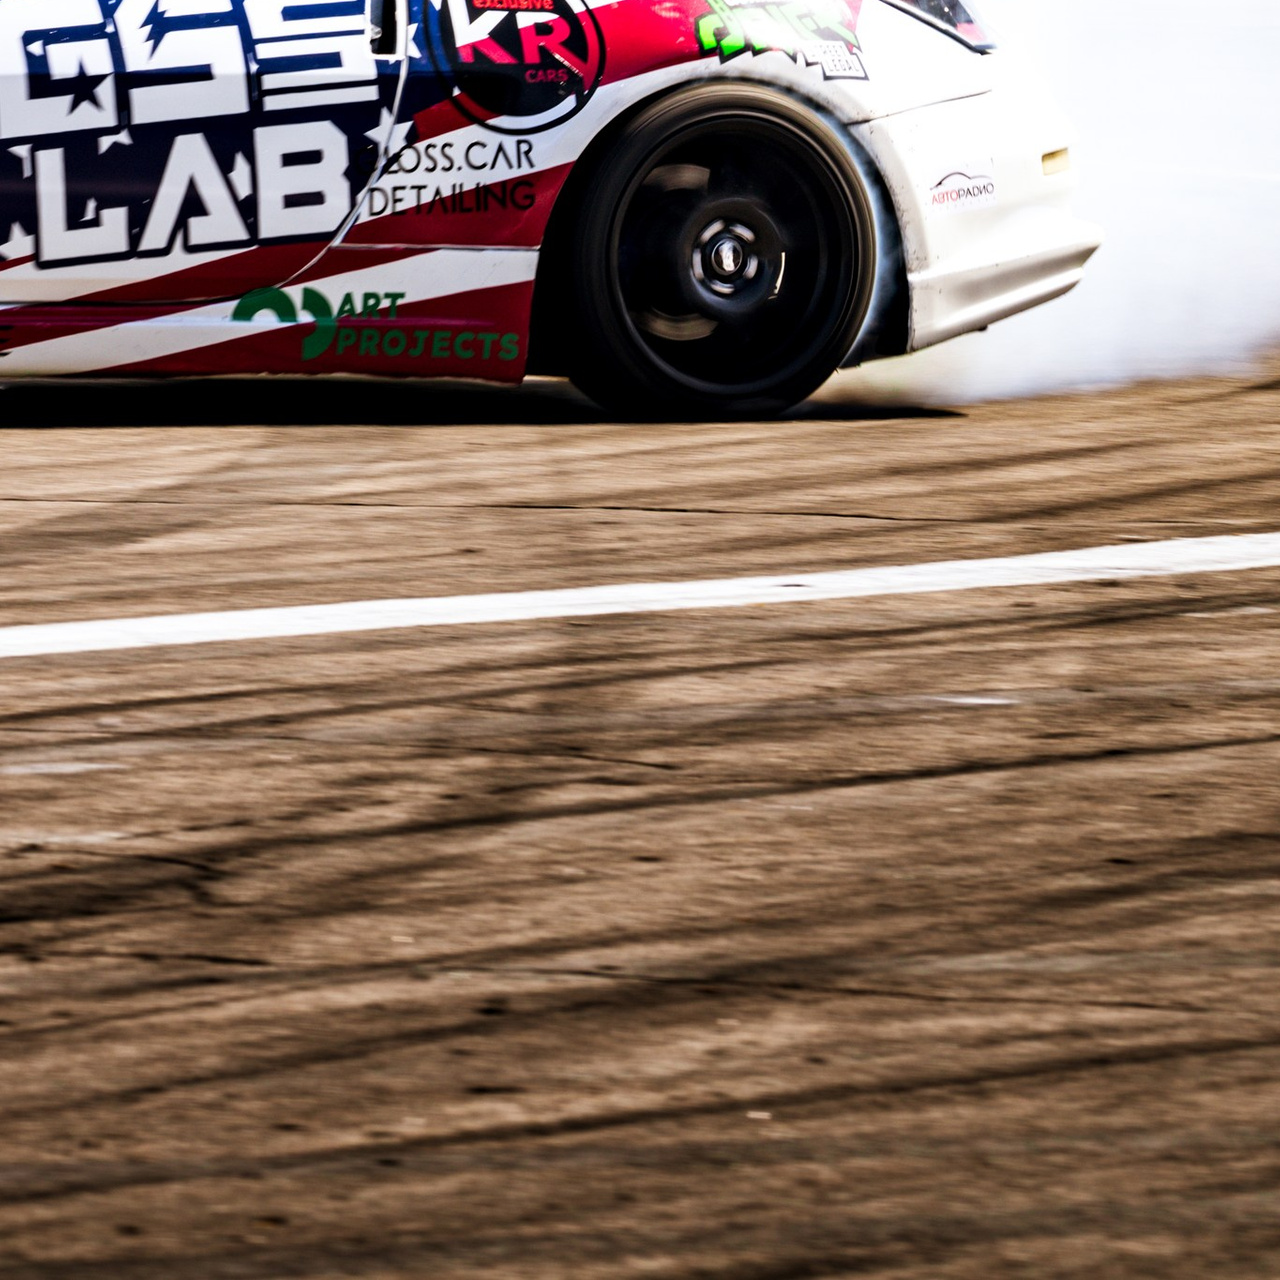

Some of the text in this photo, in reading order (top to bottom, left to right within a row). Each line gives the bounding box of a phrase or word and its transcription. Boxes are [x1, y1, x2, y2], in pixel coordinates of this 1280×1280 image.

[524, 69, 570, 84] CARS
[34, 120, 354, 263] LAB
[369, 180, 537, 218] DETAILING
[336, 291, 406, 319] ART
[335, 327, 520, 361] PROJECTS
